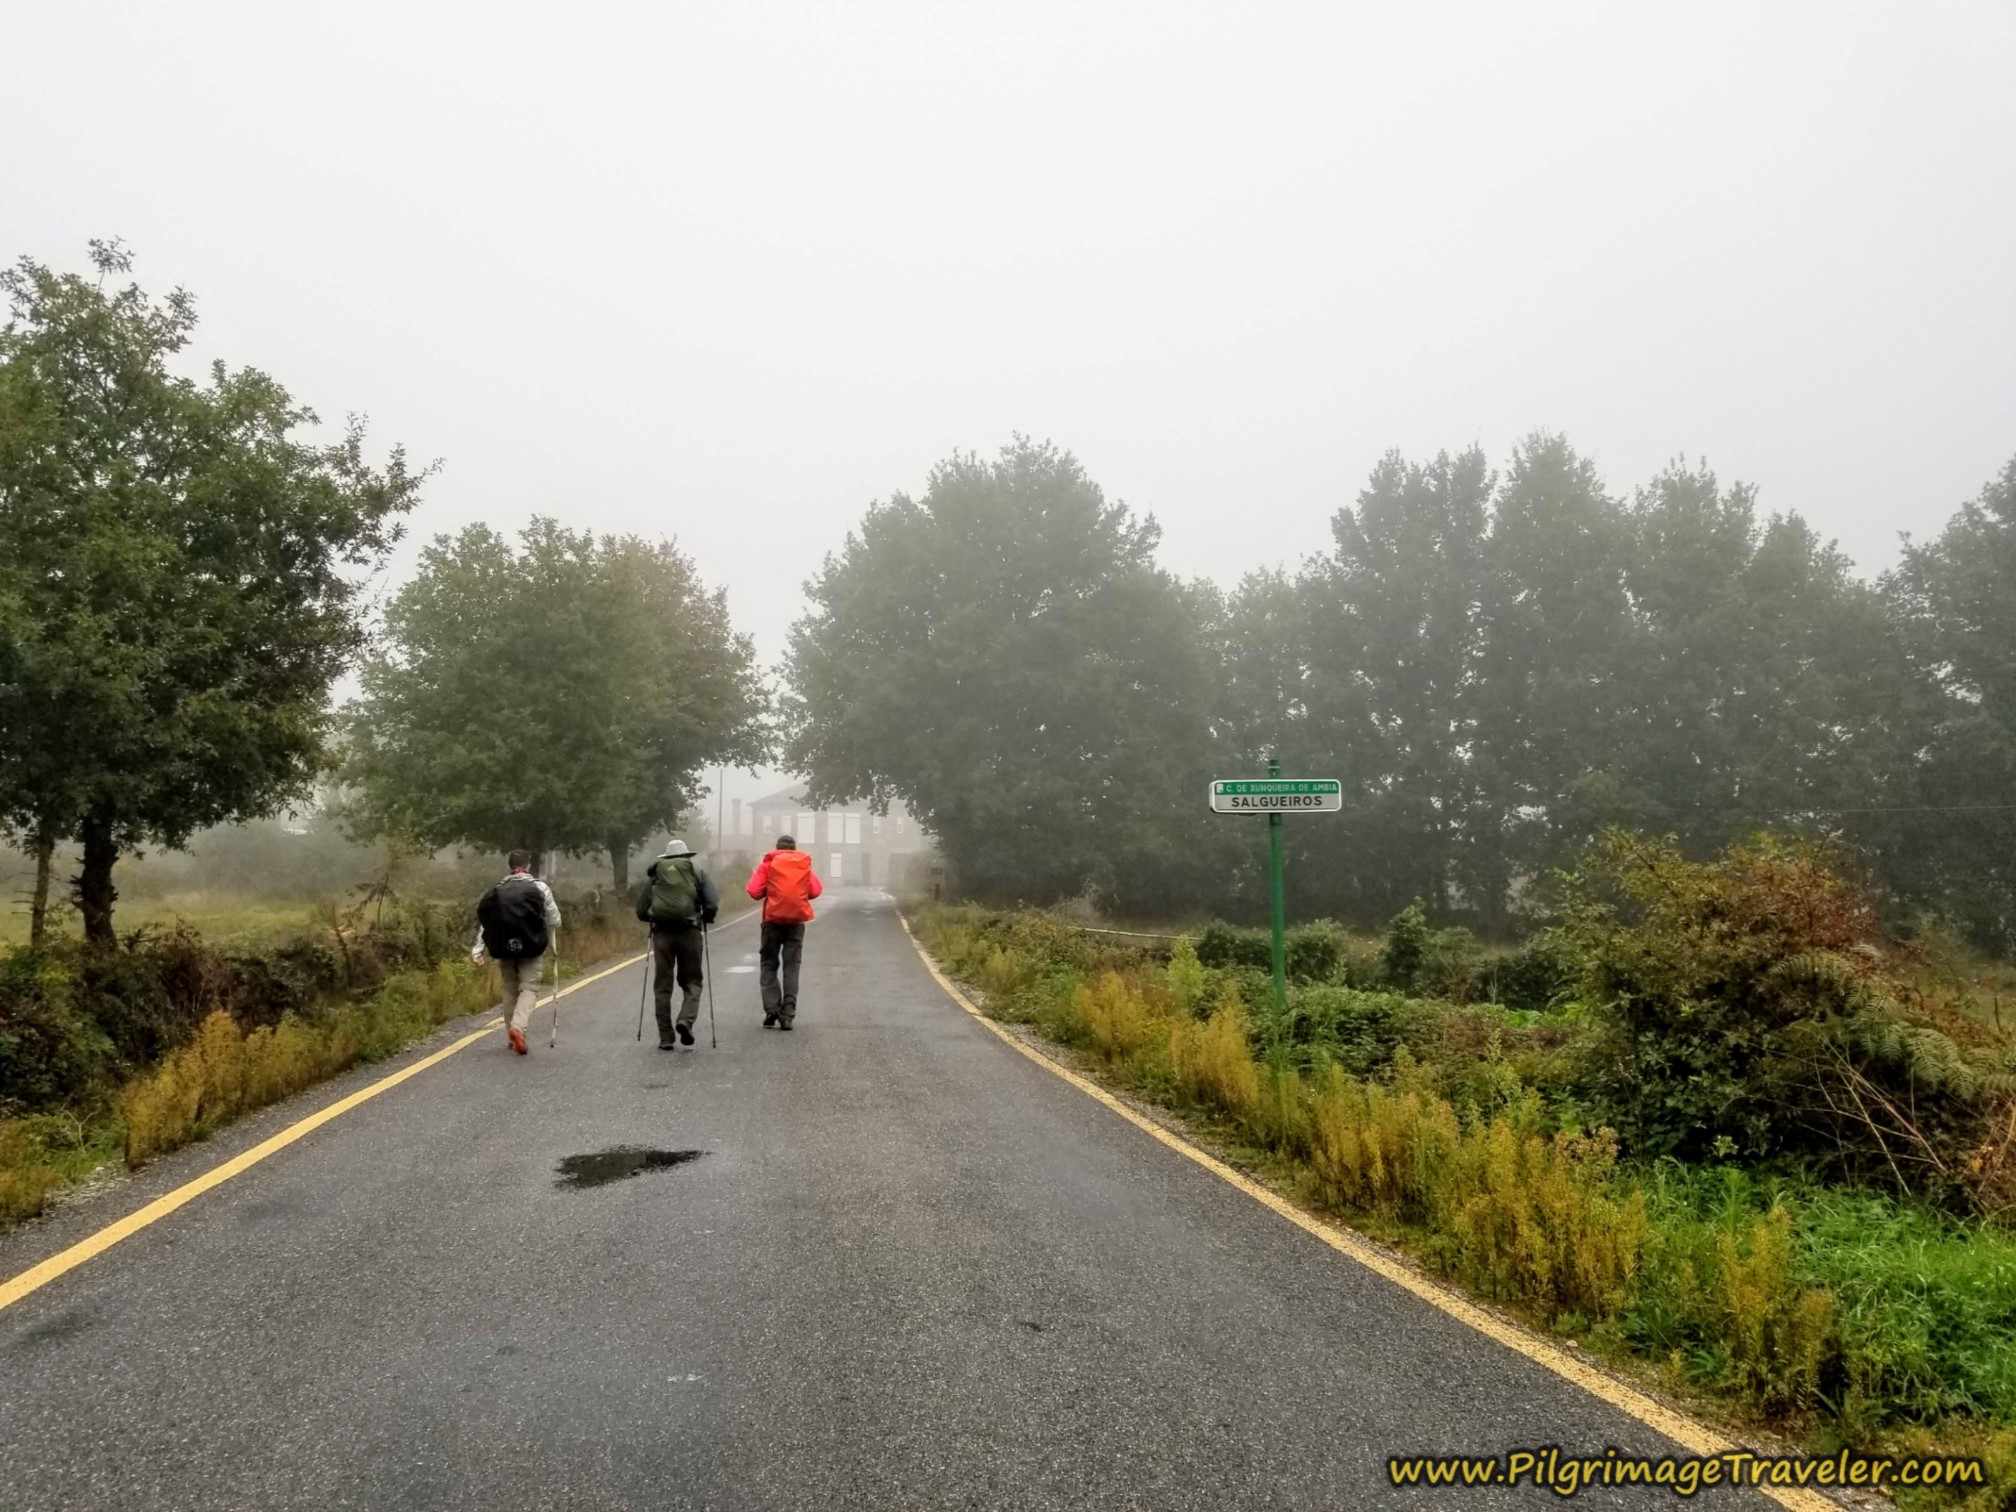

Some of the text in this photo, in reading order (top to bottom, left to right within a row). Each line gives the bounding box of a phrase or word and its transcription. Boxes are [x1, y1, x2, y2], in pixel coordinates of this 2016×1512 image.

[1236, 784, 1247, 792] DE
[1250, 783, 1296, 792] XUNQUEIRA
[1298, 783, 1309, 792] DE
[1231, 795, 1322, 808] SALGUEIROS
